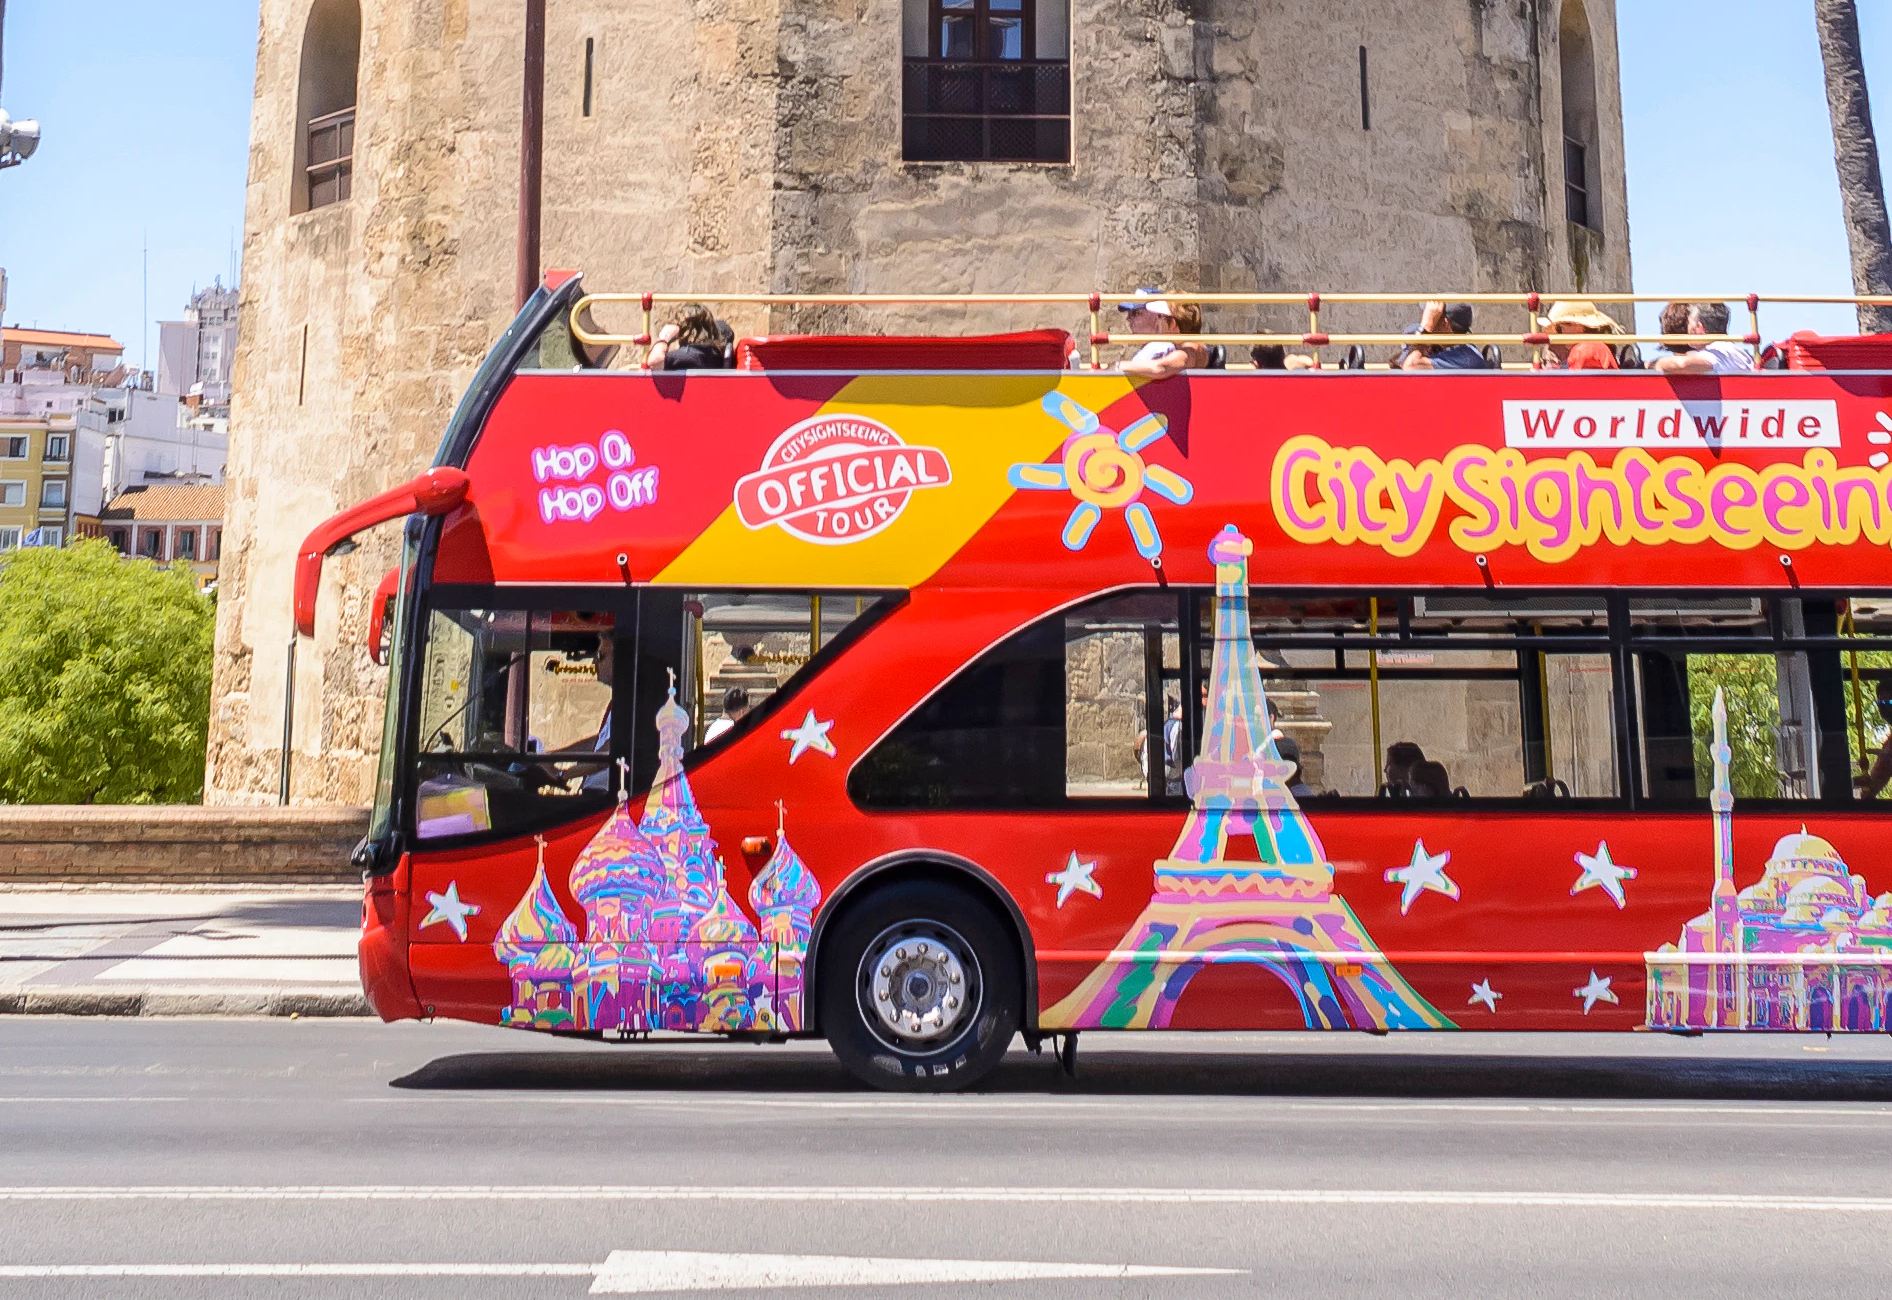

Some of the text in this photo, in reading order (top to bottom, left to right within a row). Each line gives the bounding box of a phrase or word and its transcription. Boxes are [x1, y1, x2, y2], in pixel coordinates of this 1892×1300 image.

[781, 422, 890, 463] CITYSIGHTSEEING
[1520, 408, 1822, 439] Worldwide
[532, 443, 598, 482] Hop
[539, 466, 658, 524] Hop Off
[757, 452, 939, 515] OFFICIAL
[816, 498, 897, 535] TOUR
